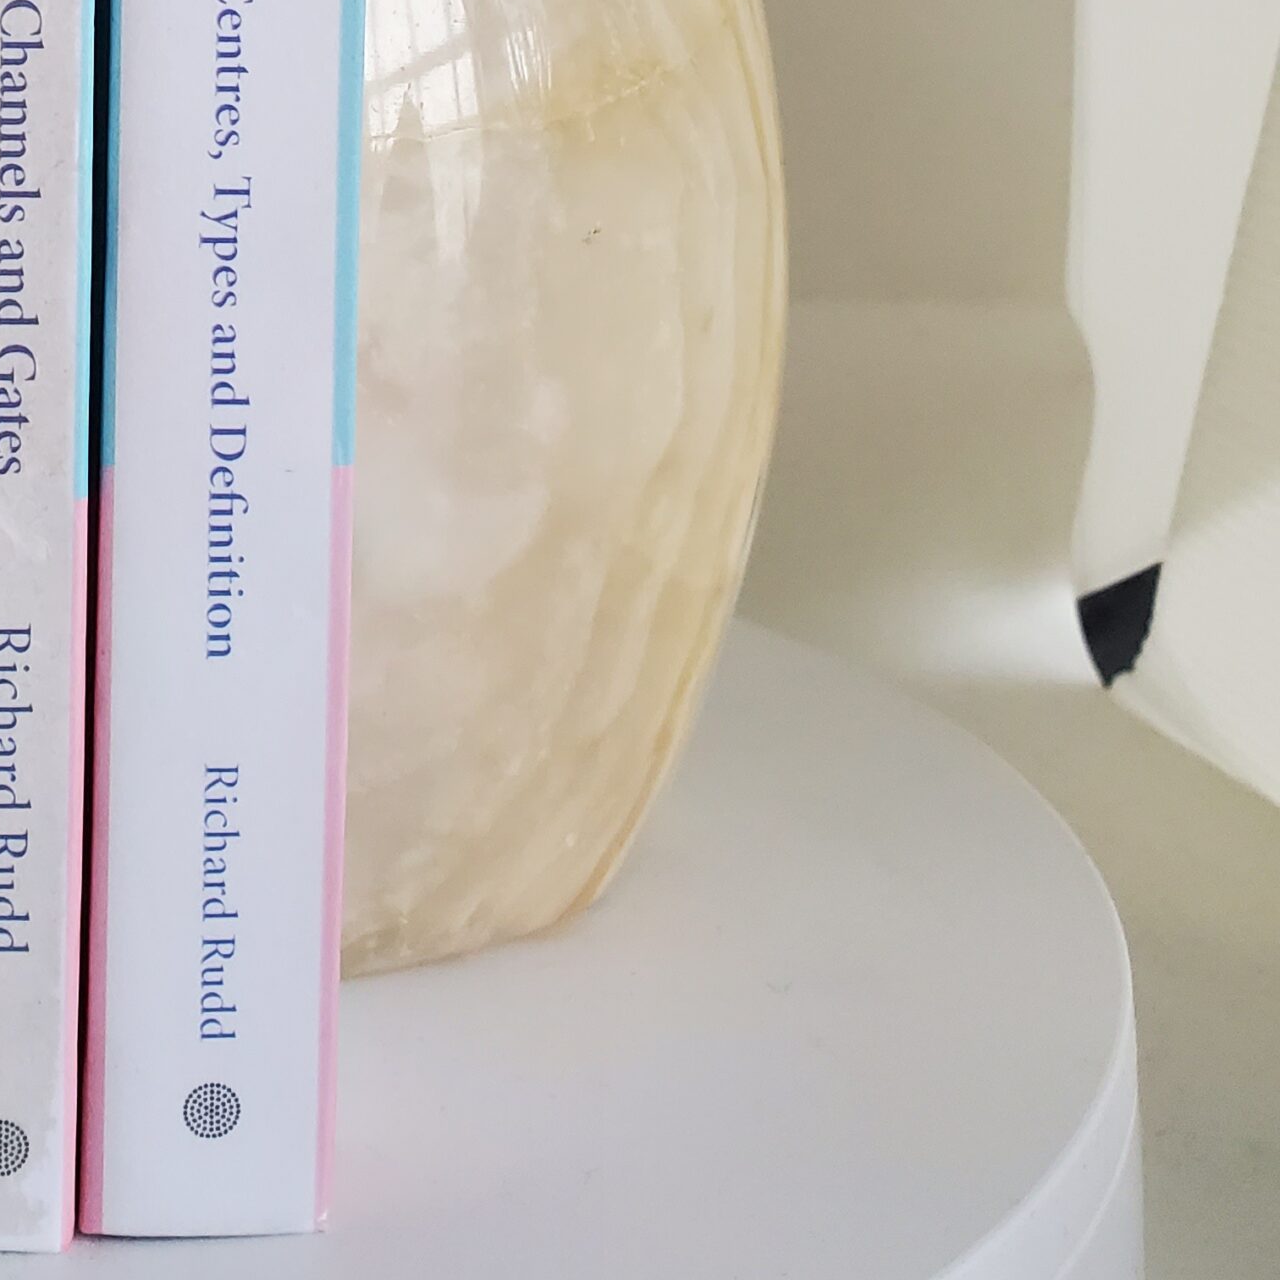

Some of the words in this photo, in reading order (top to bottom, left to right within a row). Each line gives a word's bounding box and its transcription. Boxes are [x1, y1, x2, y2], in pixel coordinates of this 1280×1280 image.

[199, 176, 252, 309] Types
[210, 323, 251, 407] and
[206, 423, 249, 659] Definition
[202, 765, 241, 922] Richard
[199, 937, 238, 1040] Rudd
